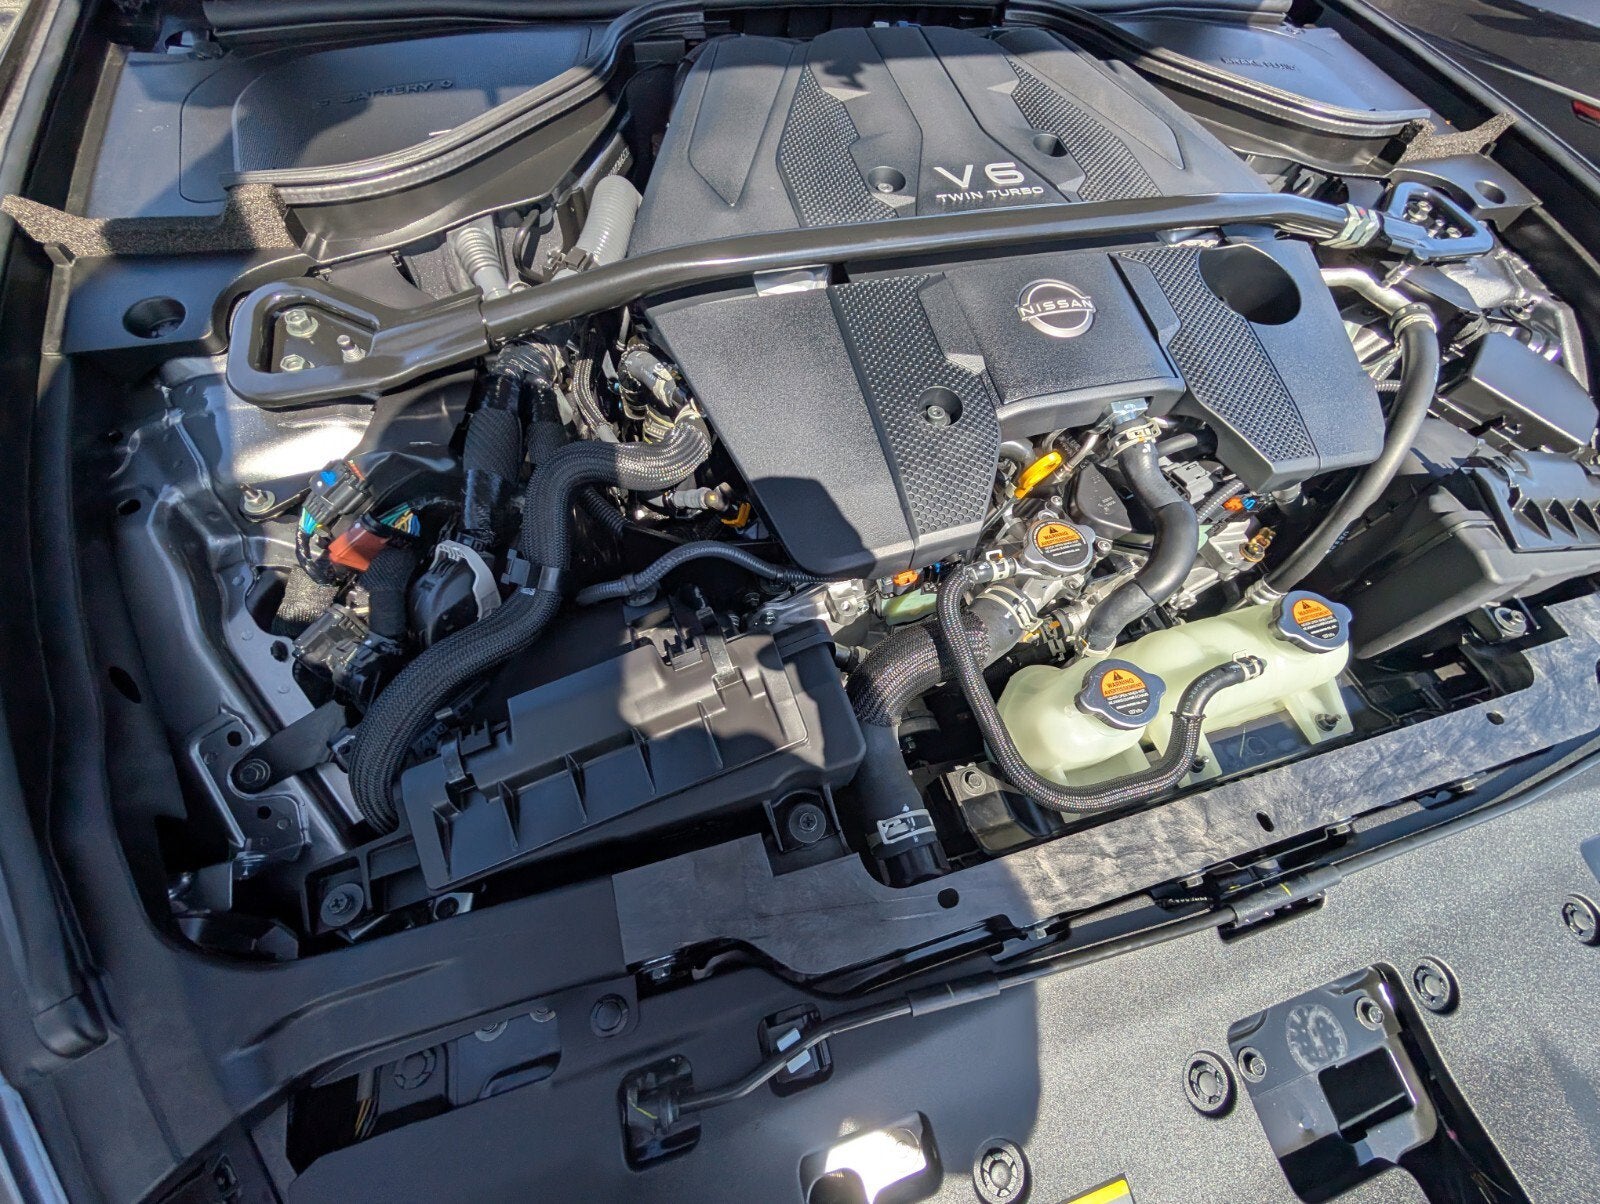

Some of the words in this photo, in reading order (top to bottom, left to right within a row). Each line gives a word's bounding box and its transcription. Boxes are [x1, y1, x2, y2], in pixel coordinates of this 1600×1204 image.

[936, 190, 984, 203] TWIN
[987, 186, 1044, 199] TURBO
[1019, 299, 1094, 317] NISSAN
[1106, 678, 1135, 688] WARNING
